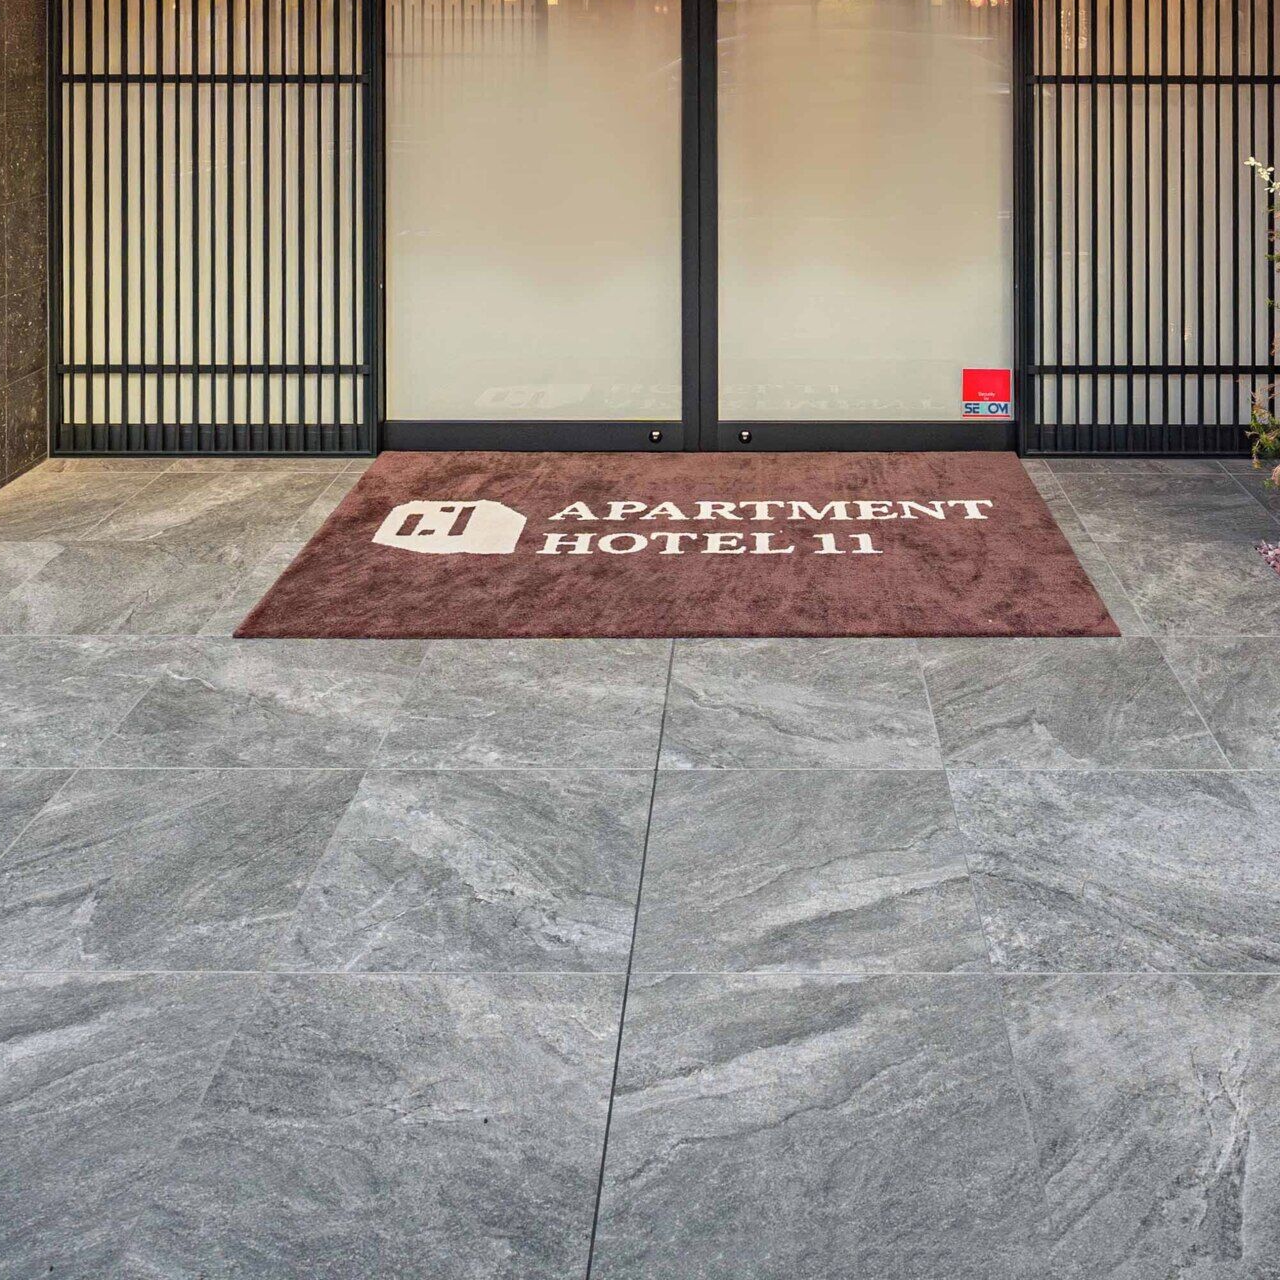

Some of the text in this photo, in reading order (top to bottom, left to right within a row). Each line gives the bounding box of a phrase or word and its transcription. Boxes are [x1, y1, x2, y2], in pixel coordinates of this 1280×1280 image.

[548, 500, 993, 521] APARTMENT
[535, 533, 884, 556] HOTEL 11
